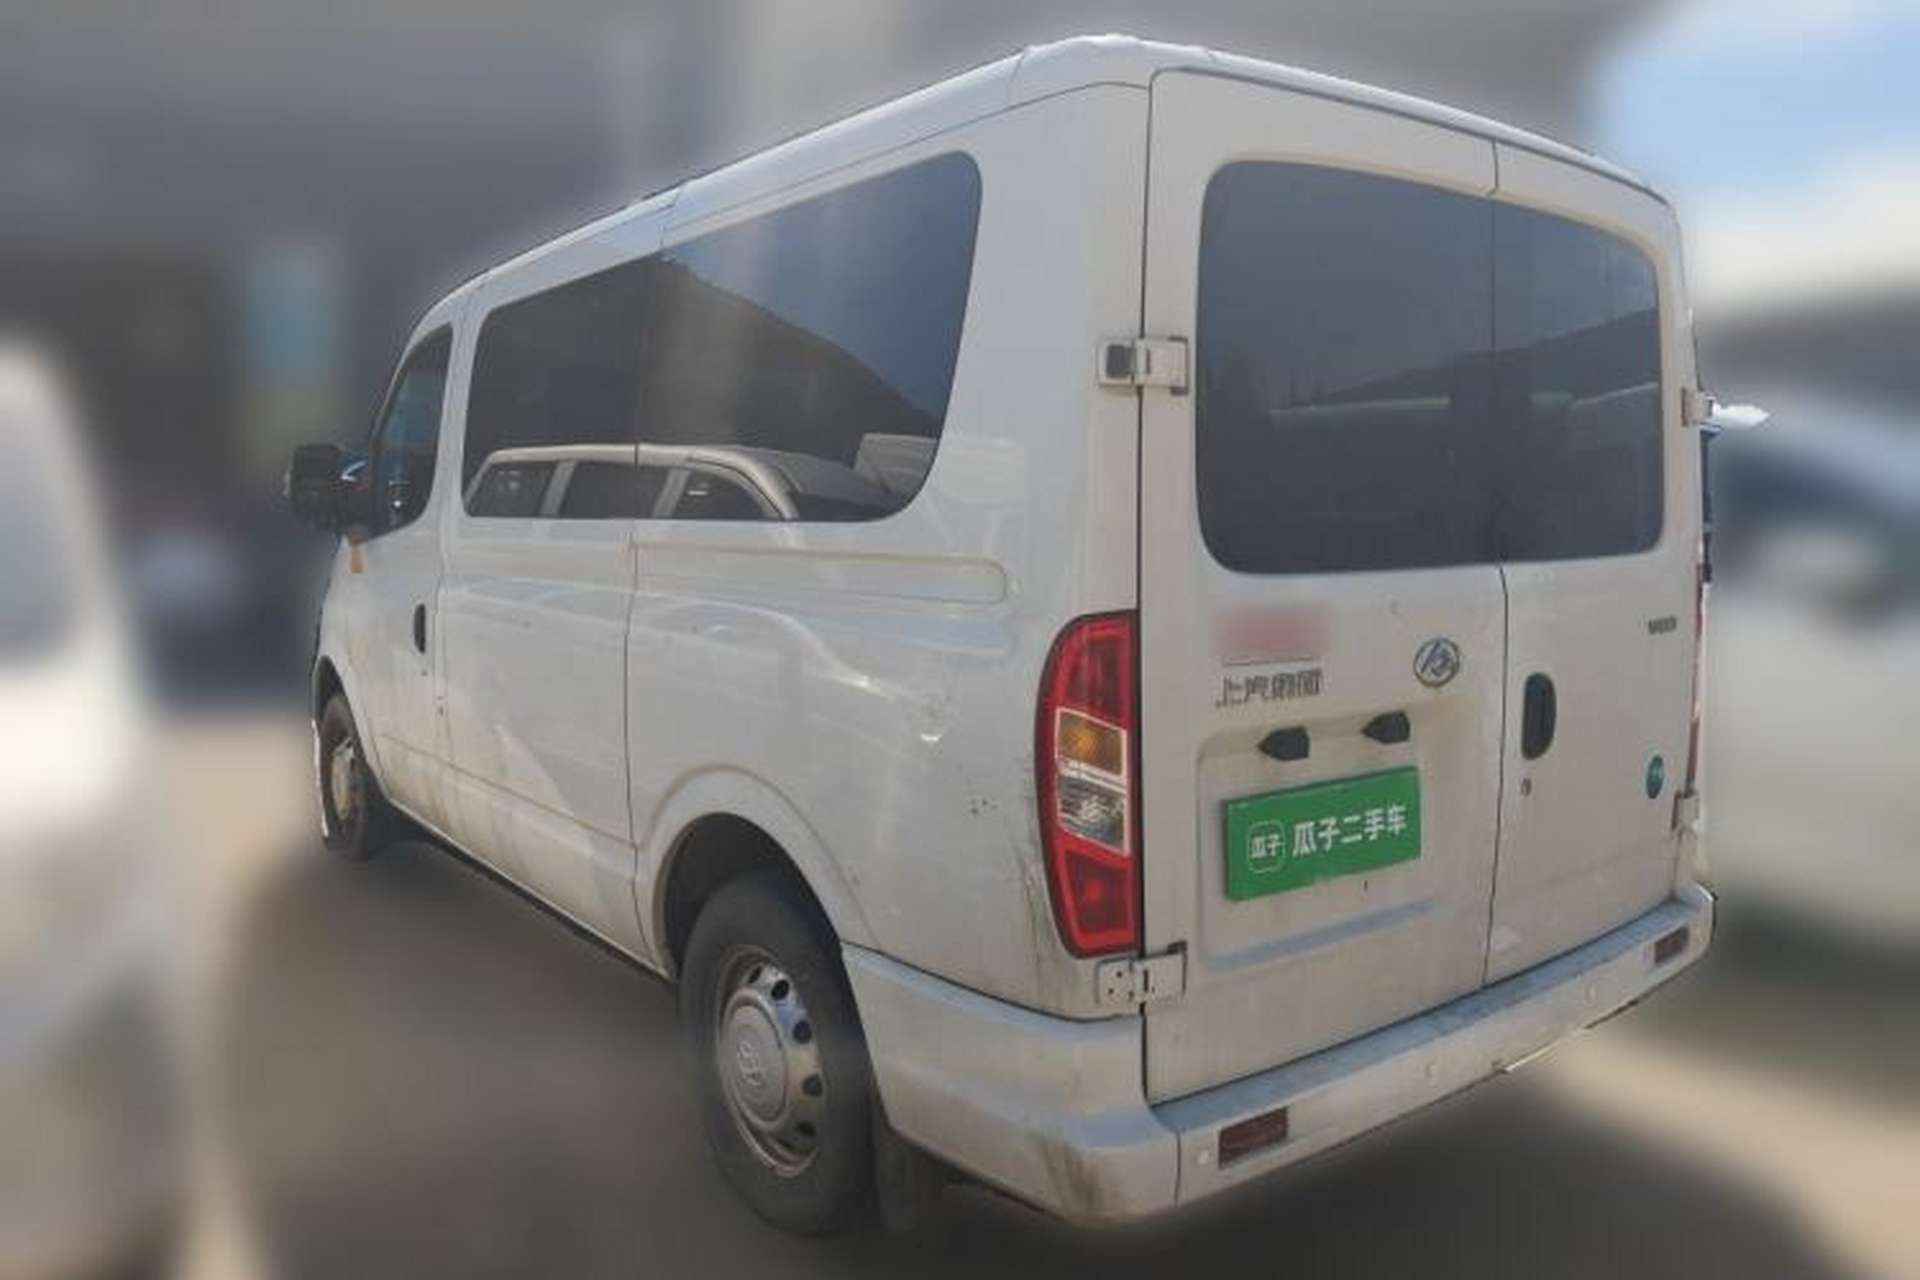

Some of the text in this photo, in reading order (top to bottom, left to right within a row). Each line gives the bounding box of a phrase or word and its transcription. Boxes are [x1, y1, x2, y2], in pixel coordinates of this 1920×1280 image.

[1251, 804, 1407, 859] 瓜子 瓜子二手车
